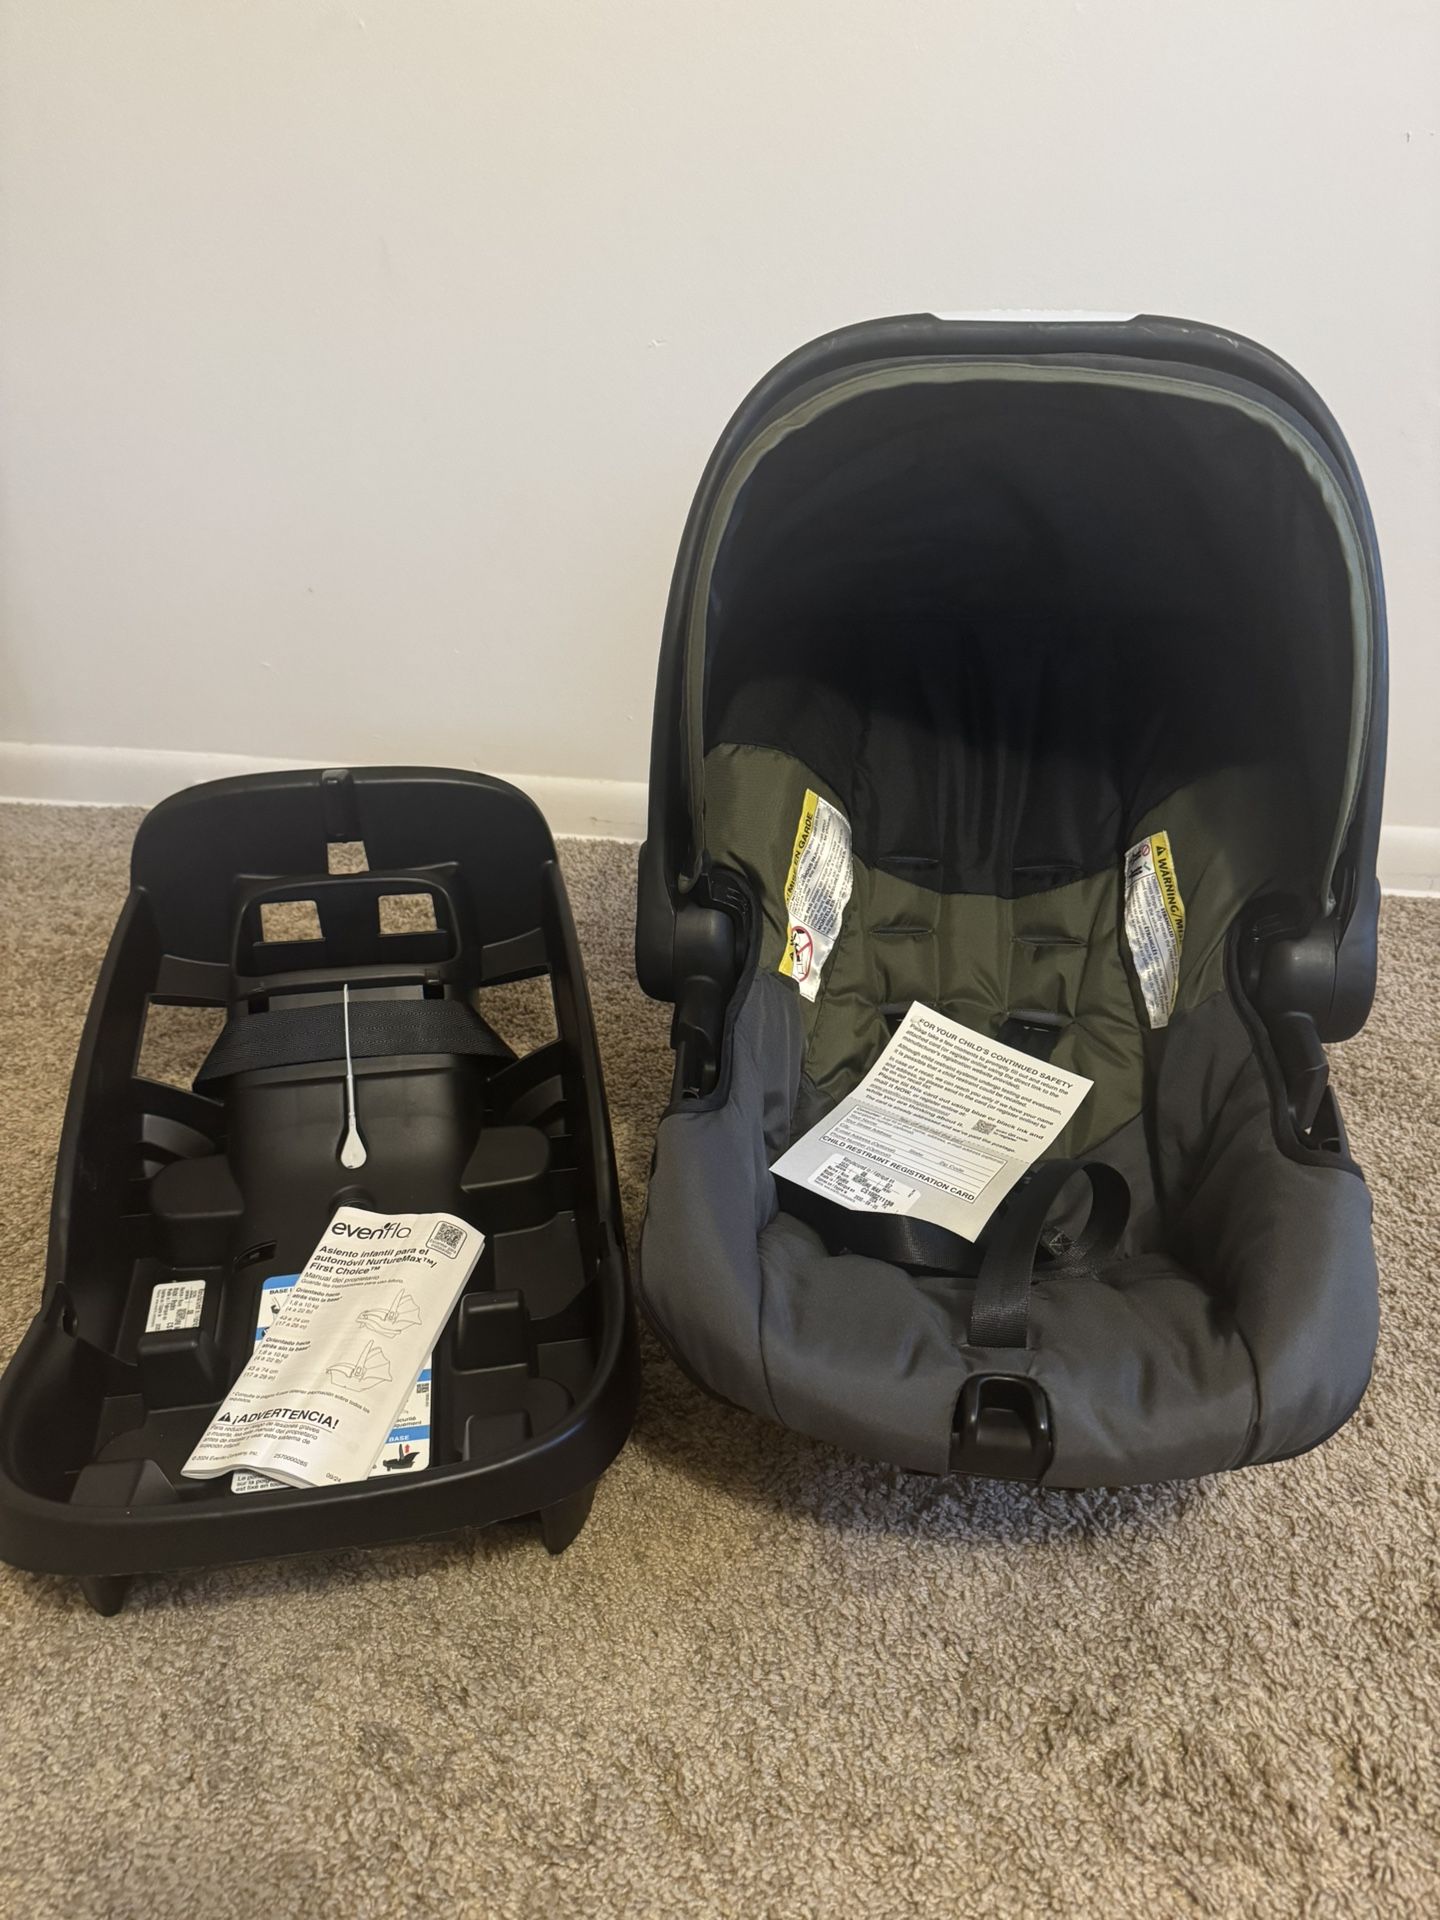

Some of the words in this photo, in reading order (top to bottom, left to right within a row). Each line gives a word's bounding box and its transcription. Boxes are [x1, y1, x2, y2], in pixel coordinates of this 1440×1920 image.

[798, 812, 813, 849] GARDE
[919, 1018, 935, 1030] FOR
[936, 1026, 957, 1040] YOUR
[958, 1038, 989, 1054] CHILD'S
[990, 1052, 1038, 1074] CONTINUED
[1039, 1072, 1072, 1088] SAFETY
[822, 1135, 845, 1146] CHILD
[846, 1144, 889, 1164] RESTRAINT
[890, 1162, 948, 1189] REGISTRATION
[950, 1187, 974, 1200] CARD
[332, 1222, 412, 1240] evenflo
[320, 1246, 358, 1258] Asiento
[360, 1250, 393, 1258] infantil
[394, 1248, 416, 1256] para
[314, 1254, 364, 1267] automóvil
[310, 1262, 333, 1273] First
[304, 1272, 331, 1283] Manual
[295, 1287, 324, 1297] Orientado
[266, 1337, 295, 1345] Orientado
[232, 1408, 339, 1429] ¡ADVERTENCIA!
